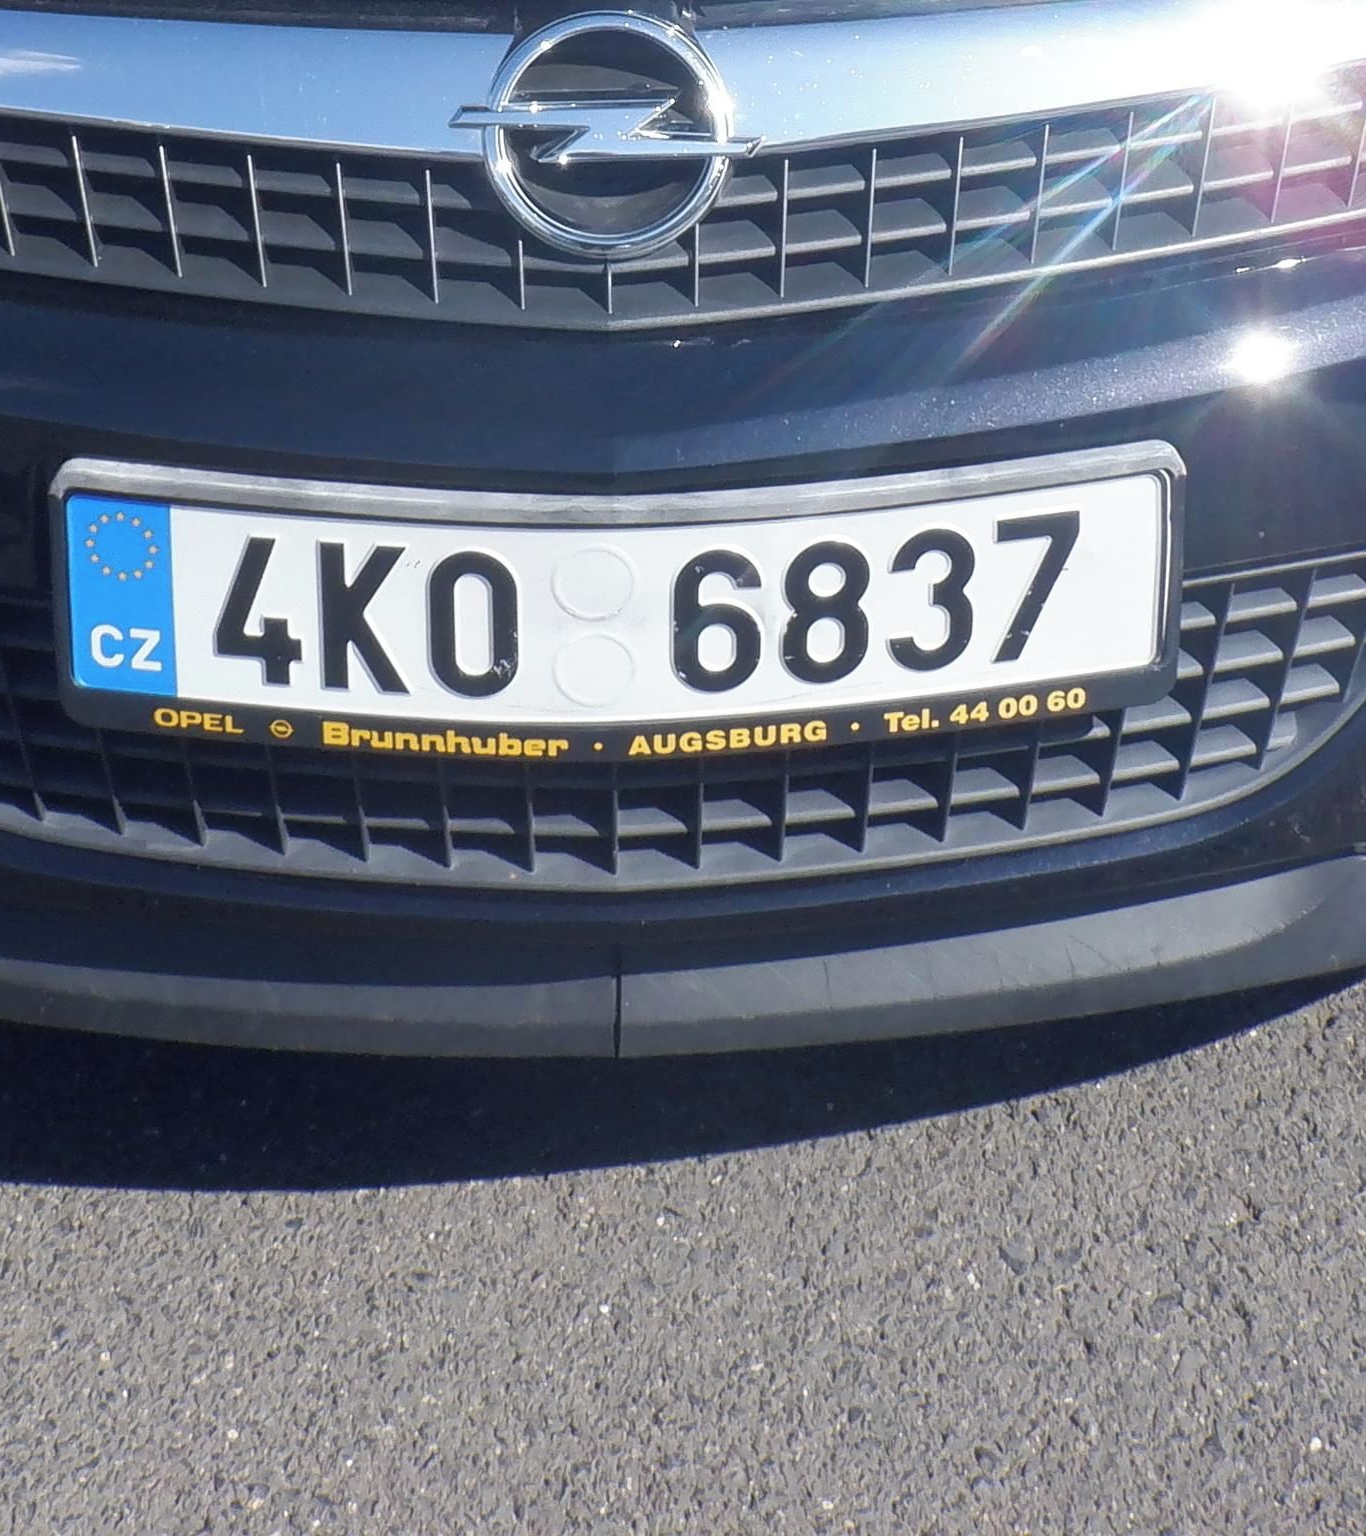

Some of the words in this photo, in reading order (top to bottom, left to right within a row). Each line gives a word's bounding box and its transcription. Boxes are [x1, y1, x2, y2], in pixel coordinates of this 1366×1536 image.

[212, 533, 519, 699] 4K0
[671, 509, 1081, 694] 6837
[90, 624, 163, 672] CZ
[153, 707, 244, 735] OPEL
[322, 720, 569, 758] Brunnhuber
[628, 720, 828, 757] AUGSBURG
[884, 707, 939, 734] Tel.
[949, 700, 990, 726] 44
[998, 693, 1038, 720] 00
[1047, 686, 1088, 714] 60
